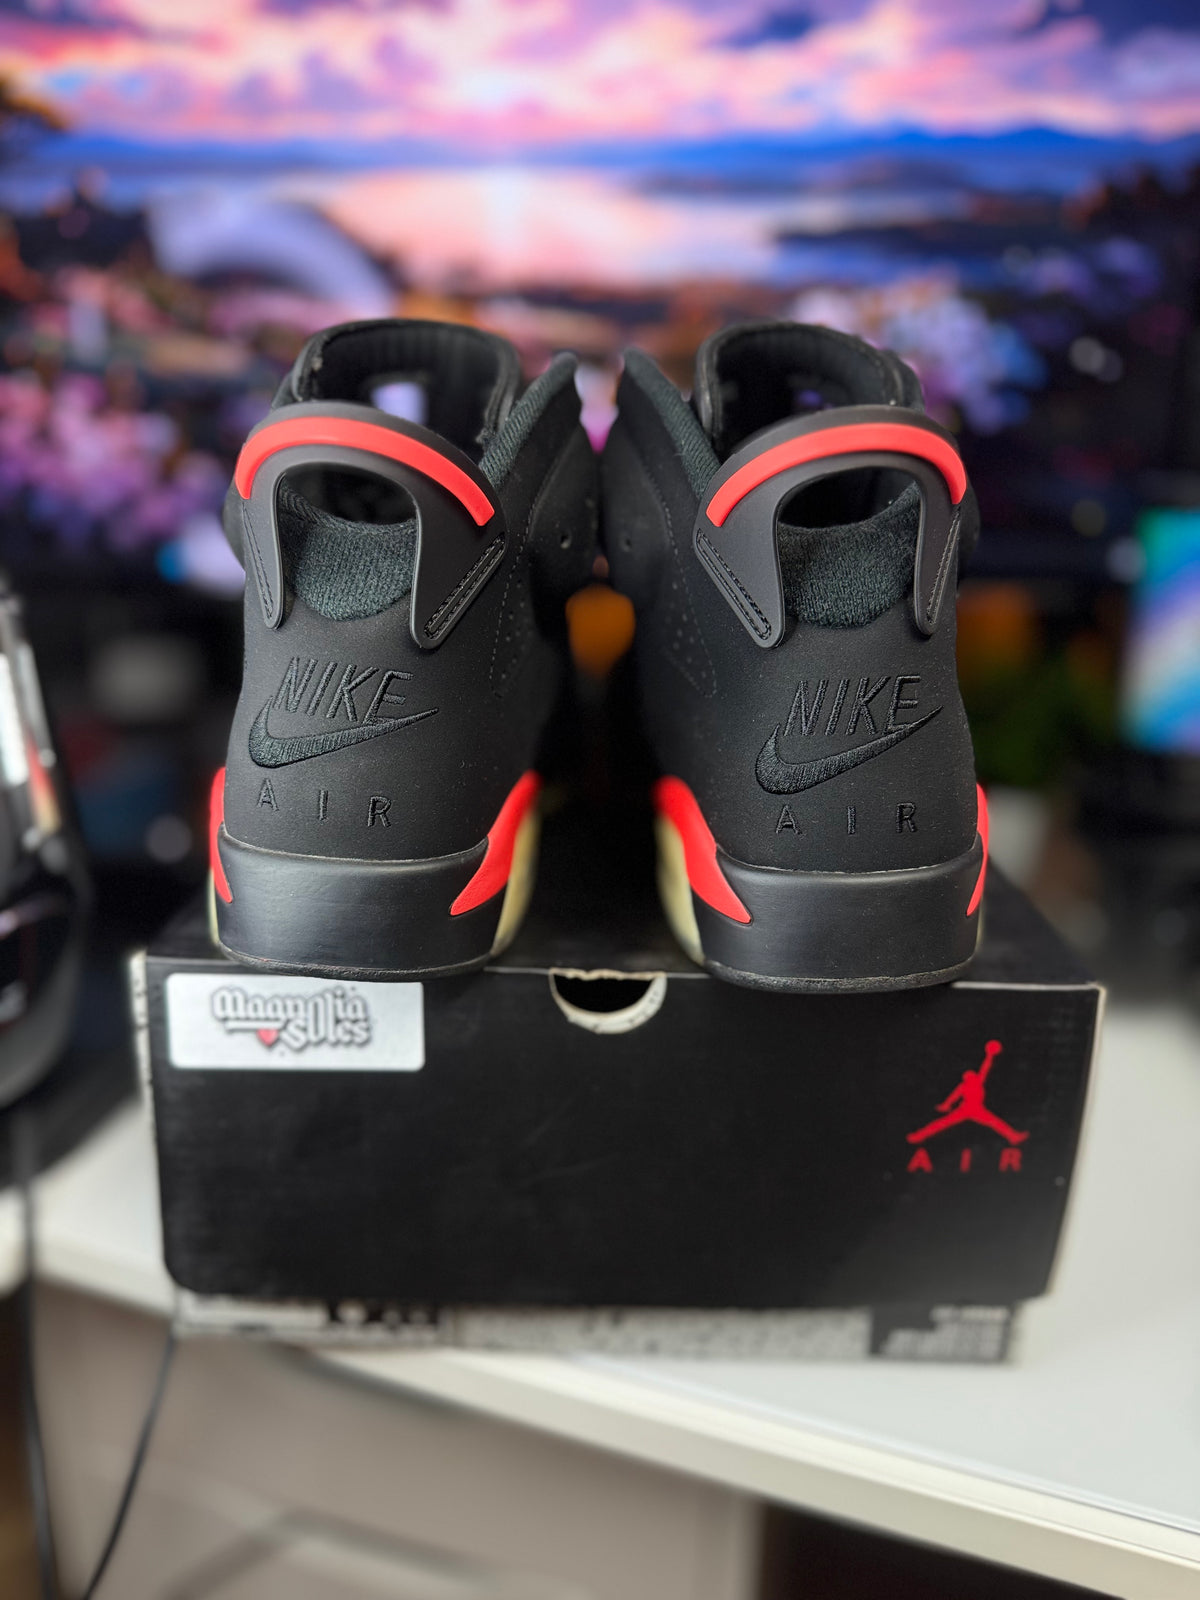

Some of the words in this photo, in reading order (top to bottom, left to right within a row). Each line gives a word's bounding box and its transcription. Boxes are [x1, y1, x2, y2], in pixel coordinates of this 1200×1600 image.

[272, 657, 414, 726] NIKE
[783, 675, 922, 735] NIKE
[257, 778, 393, 828] AIR
[775, 802, 919, 834] AIR
[907, 1148, 1023, 1173] AIR
